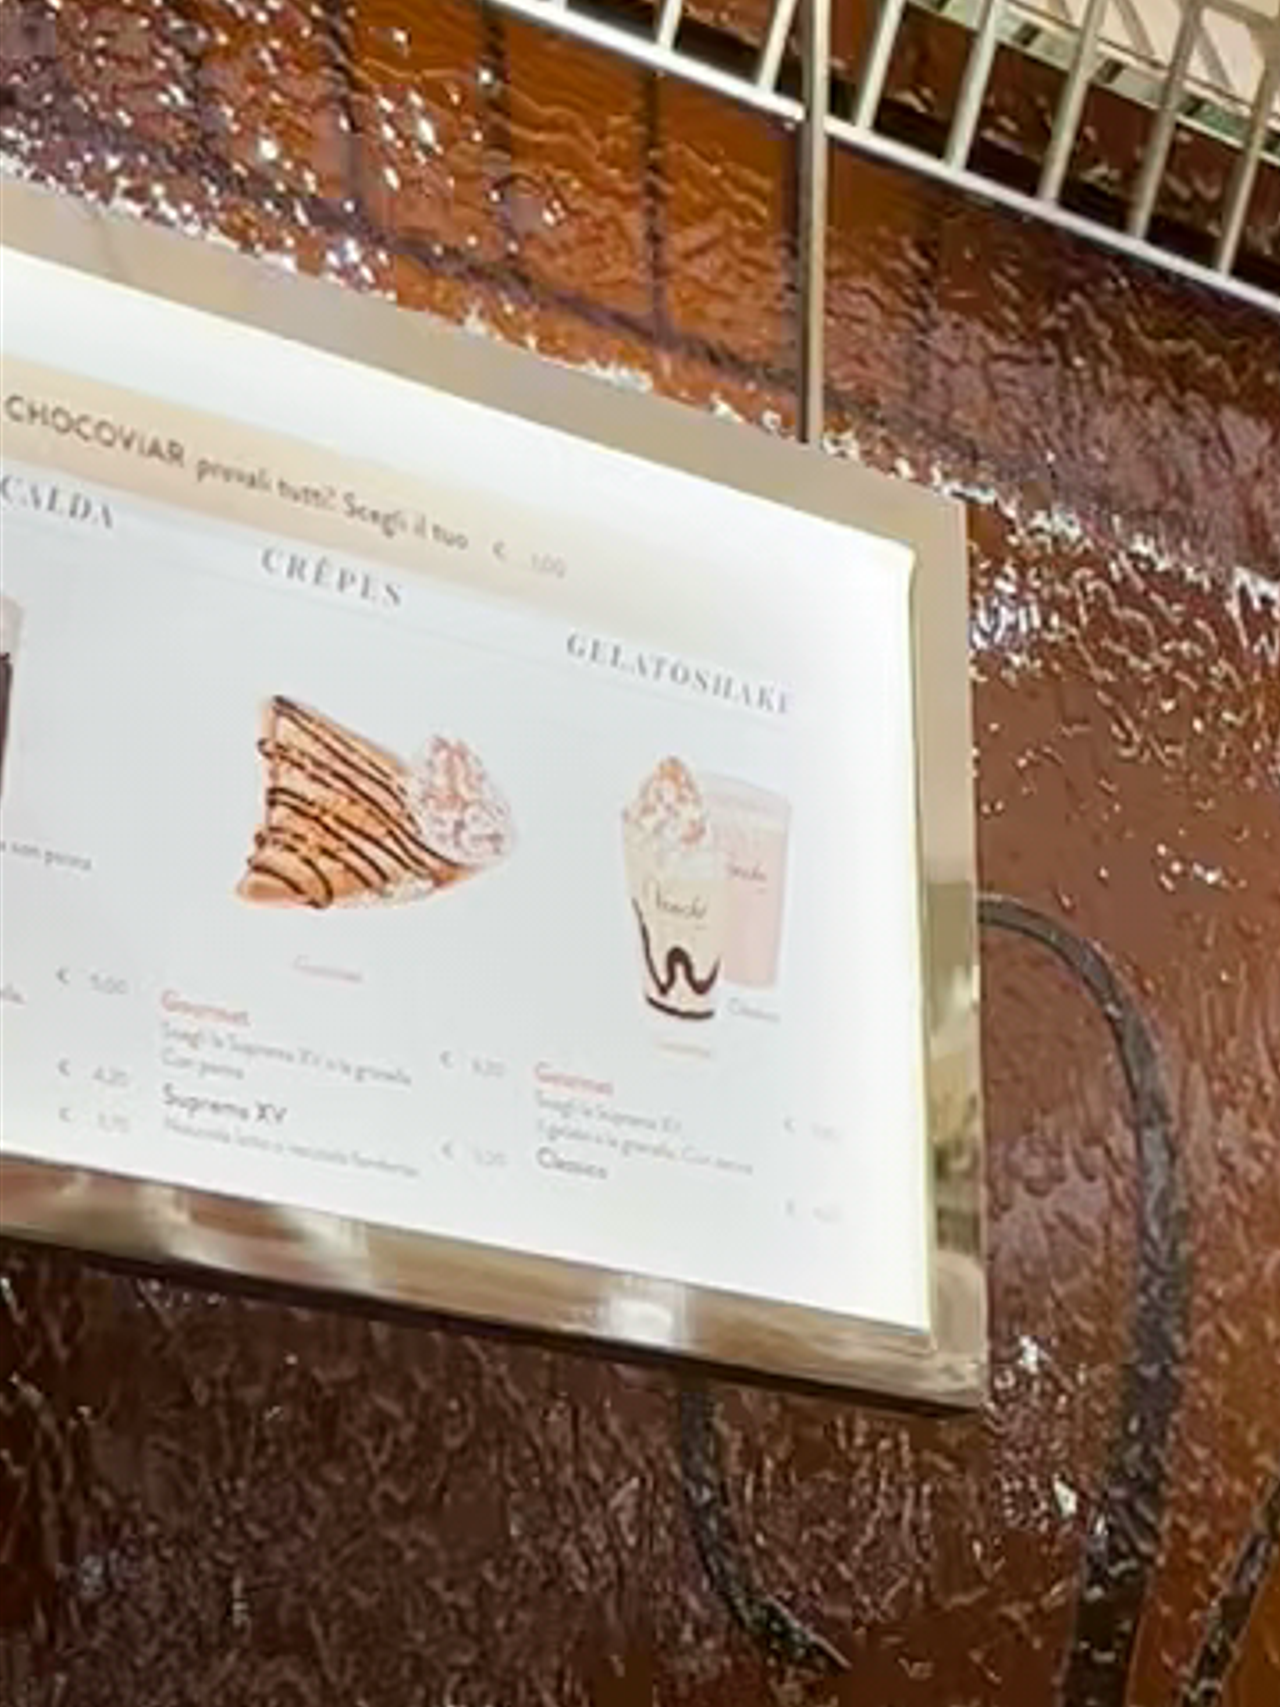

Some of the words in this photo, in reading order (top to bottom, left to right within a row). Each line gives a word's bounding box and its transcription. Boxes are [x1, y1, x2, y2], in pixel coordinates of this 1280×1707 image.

[0, 471, 116, 531] CALDA
[2, 392, 187, 469] CHOCOVIAR
[343, 490, 407, 541] Scegli
[413, 505, 429, 540] il
[431, 519, 470, 552] tuo
[260, 545, 403, 608] CRÊPES
[564, 628, 794, 717] GELATOSHAKE
[254, 1099, 289, 1126] XV
